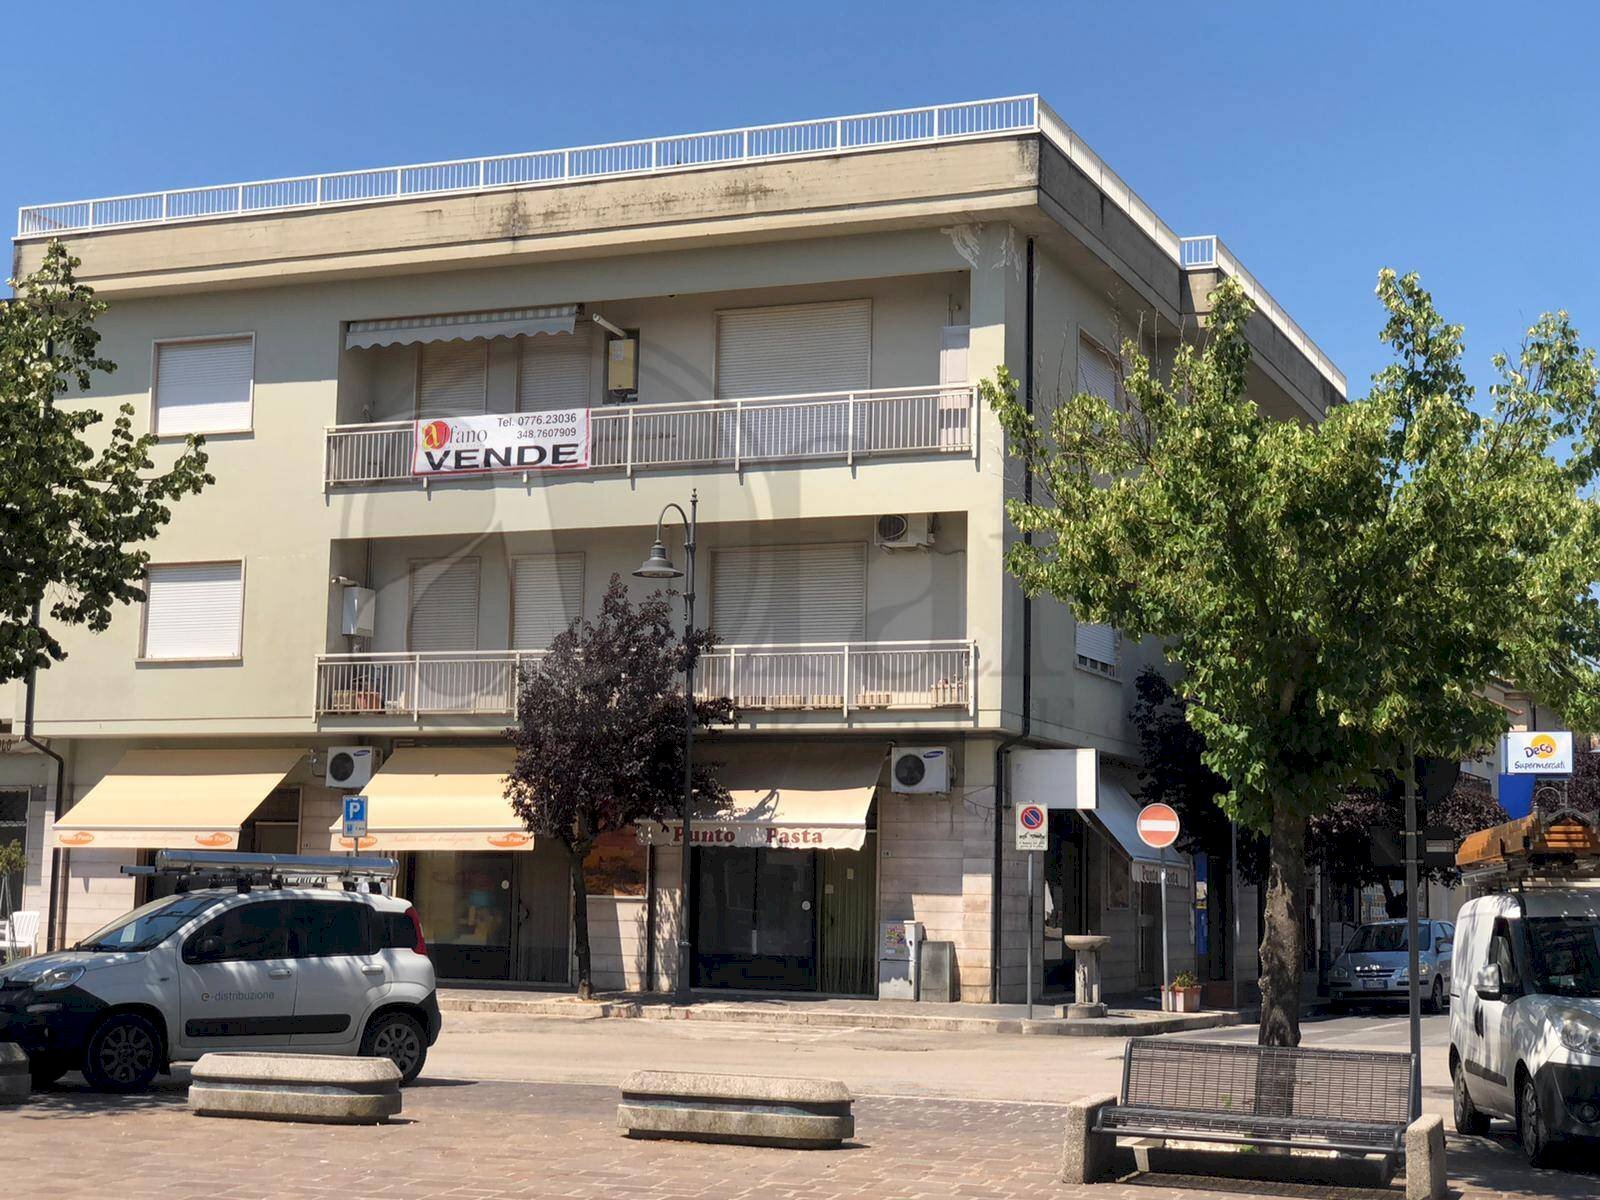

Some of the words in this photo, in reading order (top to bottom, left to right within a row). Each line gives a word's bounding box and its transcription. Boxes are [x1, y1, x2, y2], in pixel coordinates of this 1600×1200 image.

[497, 417, 514, 428] Tel.
[517, 413, 577, 426] 0776.23036
[516, 427, 577, 439] 348.7607909
[424, 444, 579, 471] VENDE
[1514, 760, 1566, 770] Supermercati
[350, 802, 361, 819] P
[673, 826, 736, 844] Punto
[765, 827, 824, 844] Pasta
[201, 991, 275, 1002] e-distribuzione
